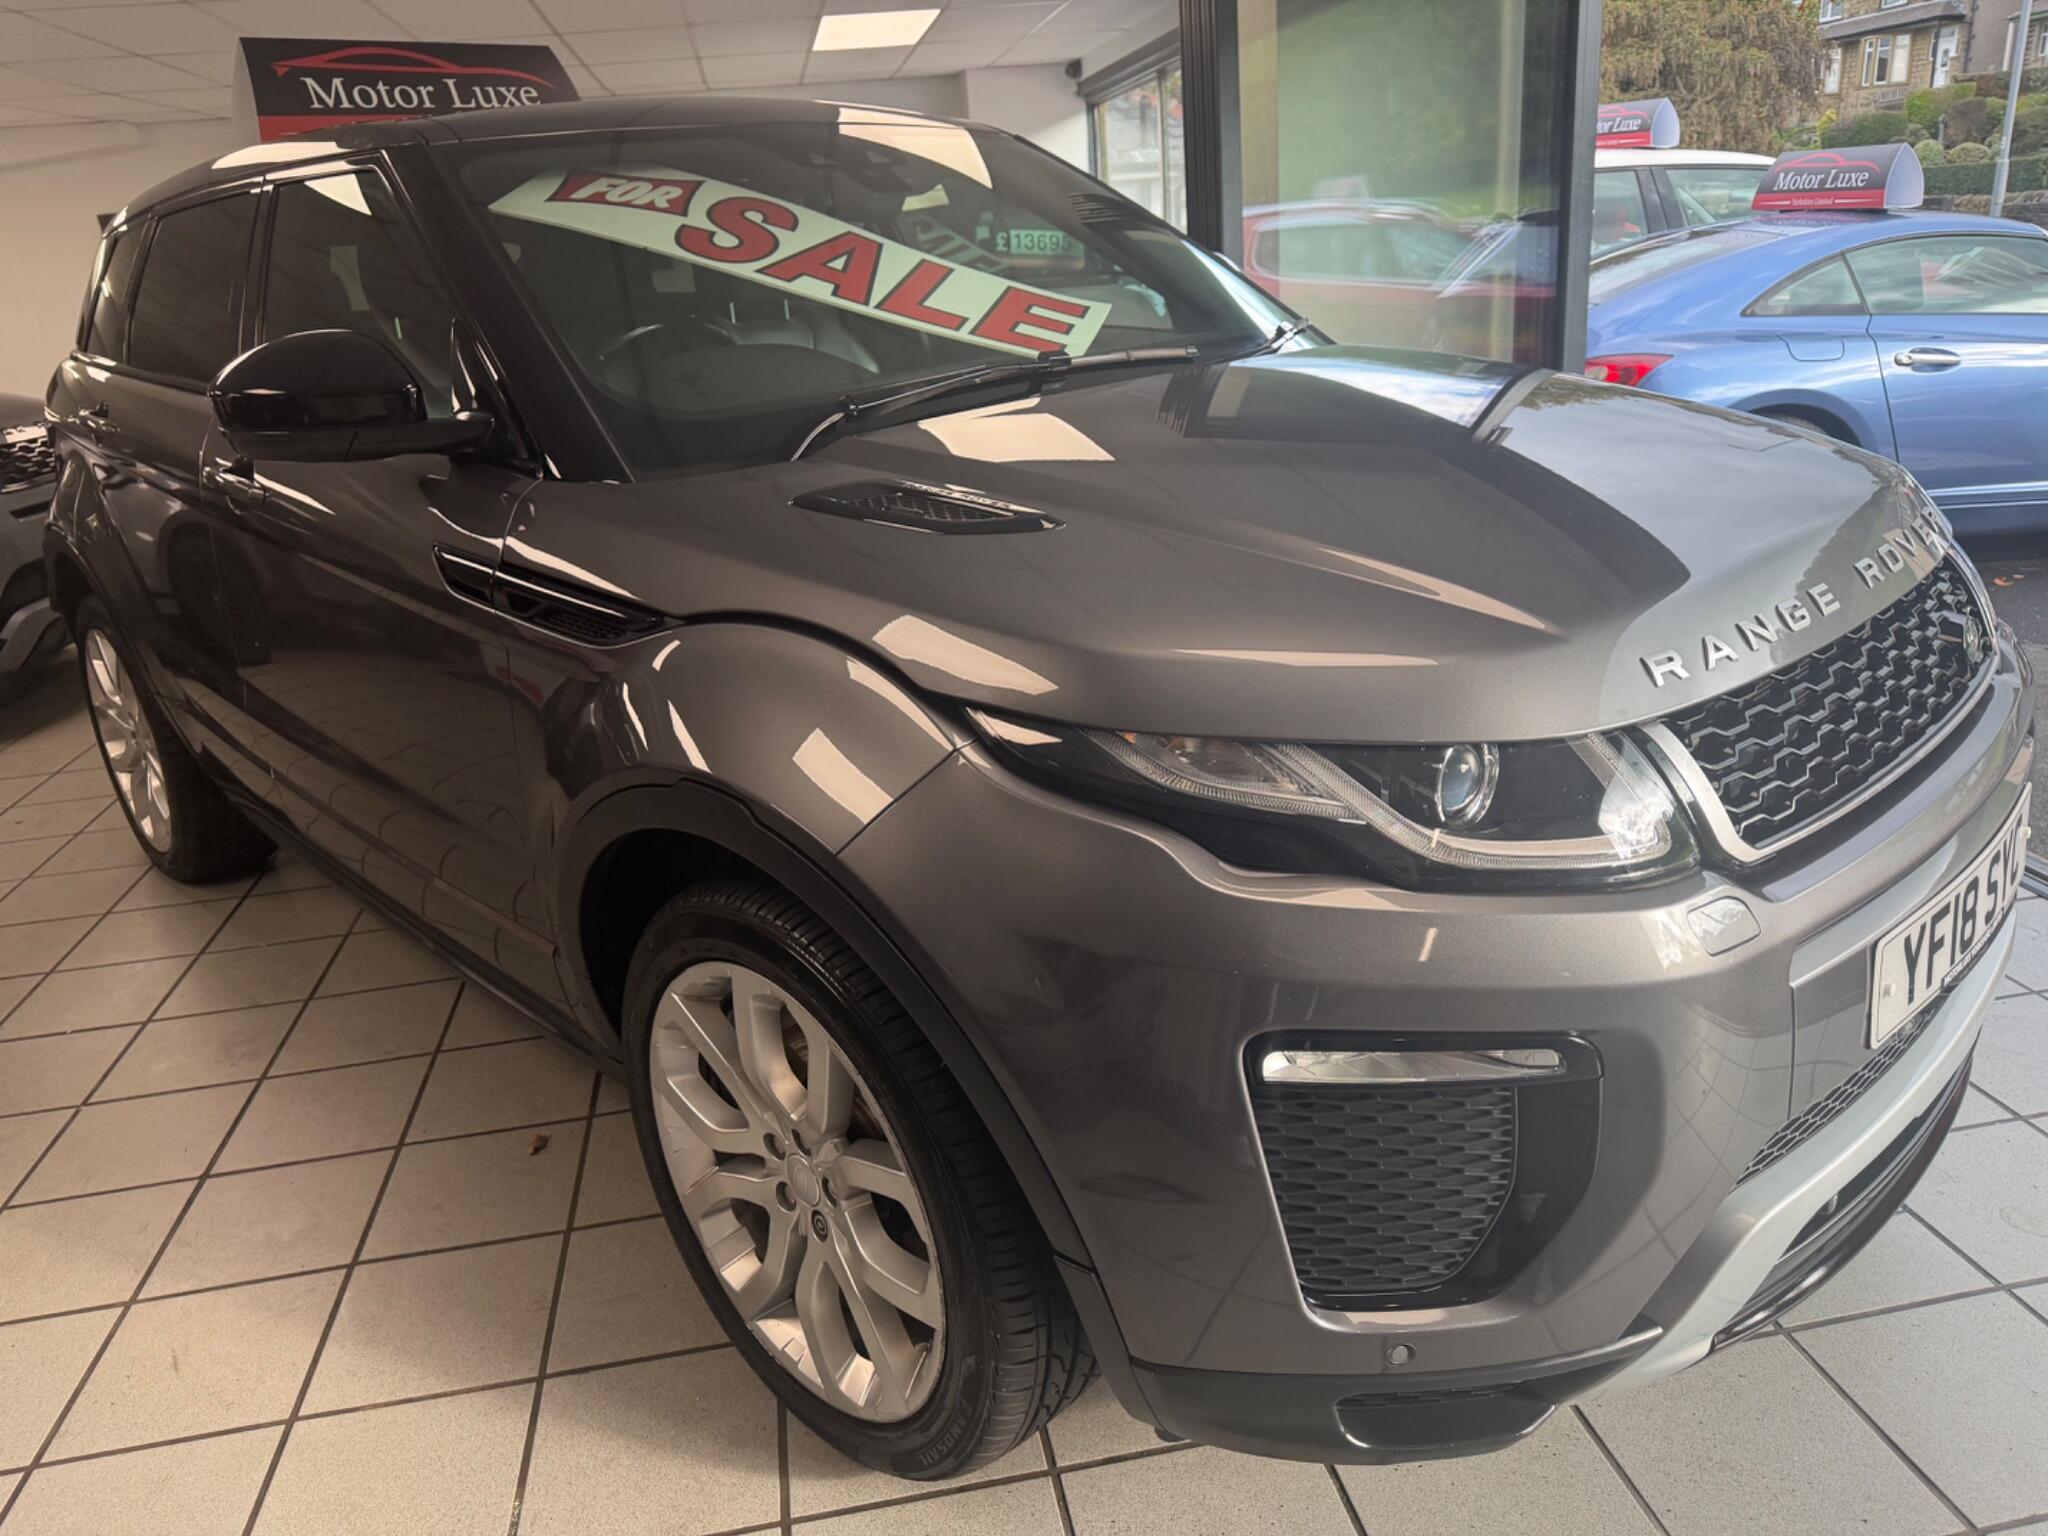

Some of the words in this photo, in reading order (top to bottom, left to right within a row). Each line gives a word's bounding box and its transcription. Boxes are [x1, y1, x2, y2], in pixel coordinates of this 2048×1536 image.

[300, 76, 434, 109] Motor
[443, 78, 541, 109] Luxe
[1611, 116, 1642, 132] Luxe
[1772, 171, 1825, 191] Motor
[1823, 168, 1869, 189] Luxe
[569, 176, 683, 209] FOR
[675, 196, 1090, 354] SALE
[1641, 581, 1841, 688] RANGE
[1853, 505, 1941, 589] ROVER
[1903, 875, 1979, 1006] YF18
